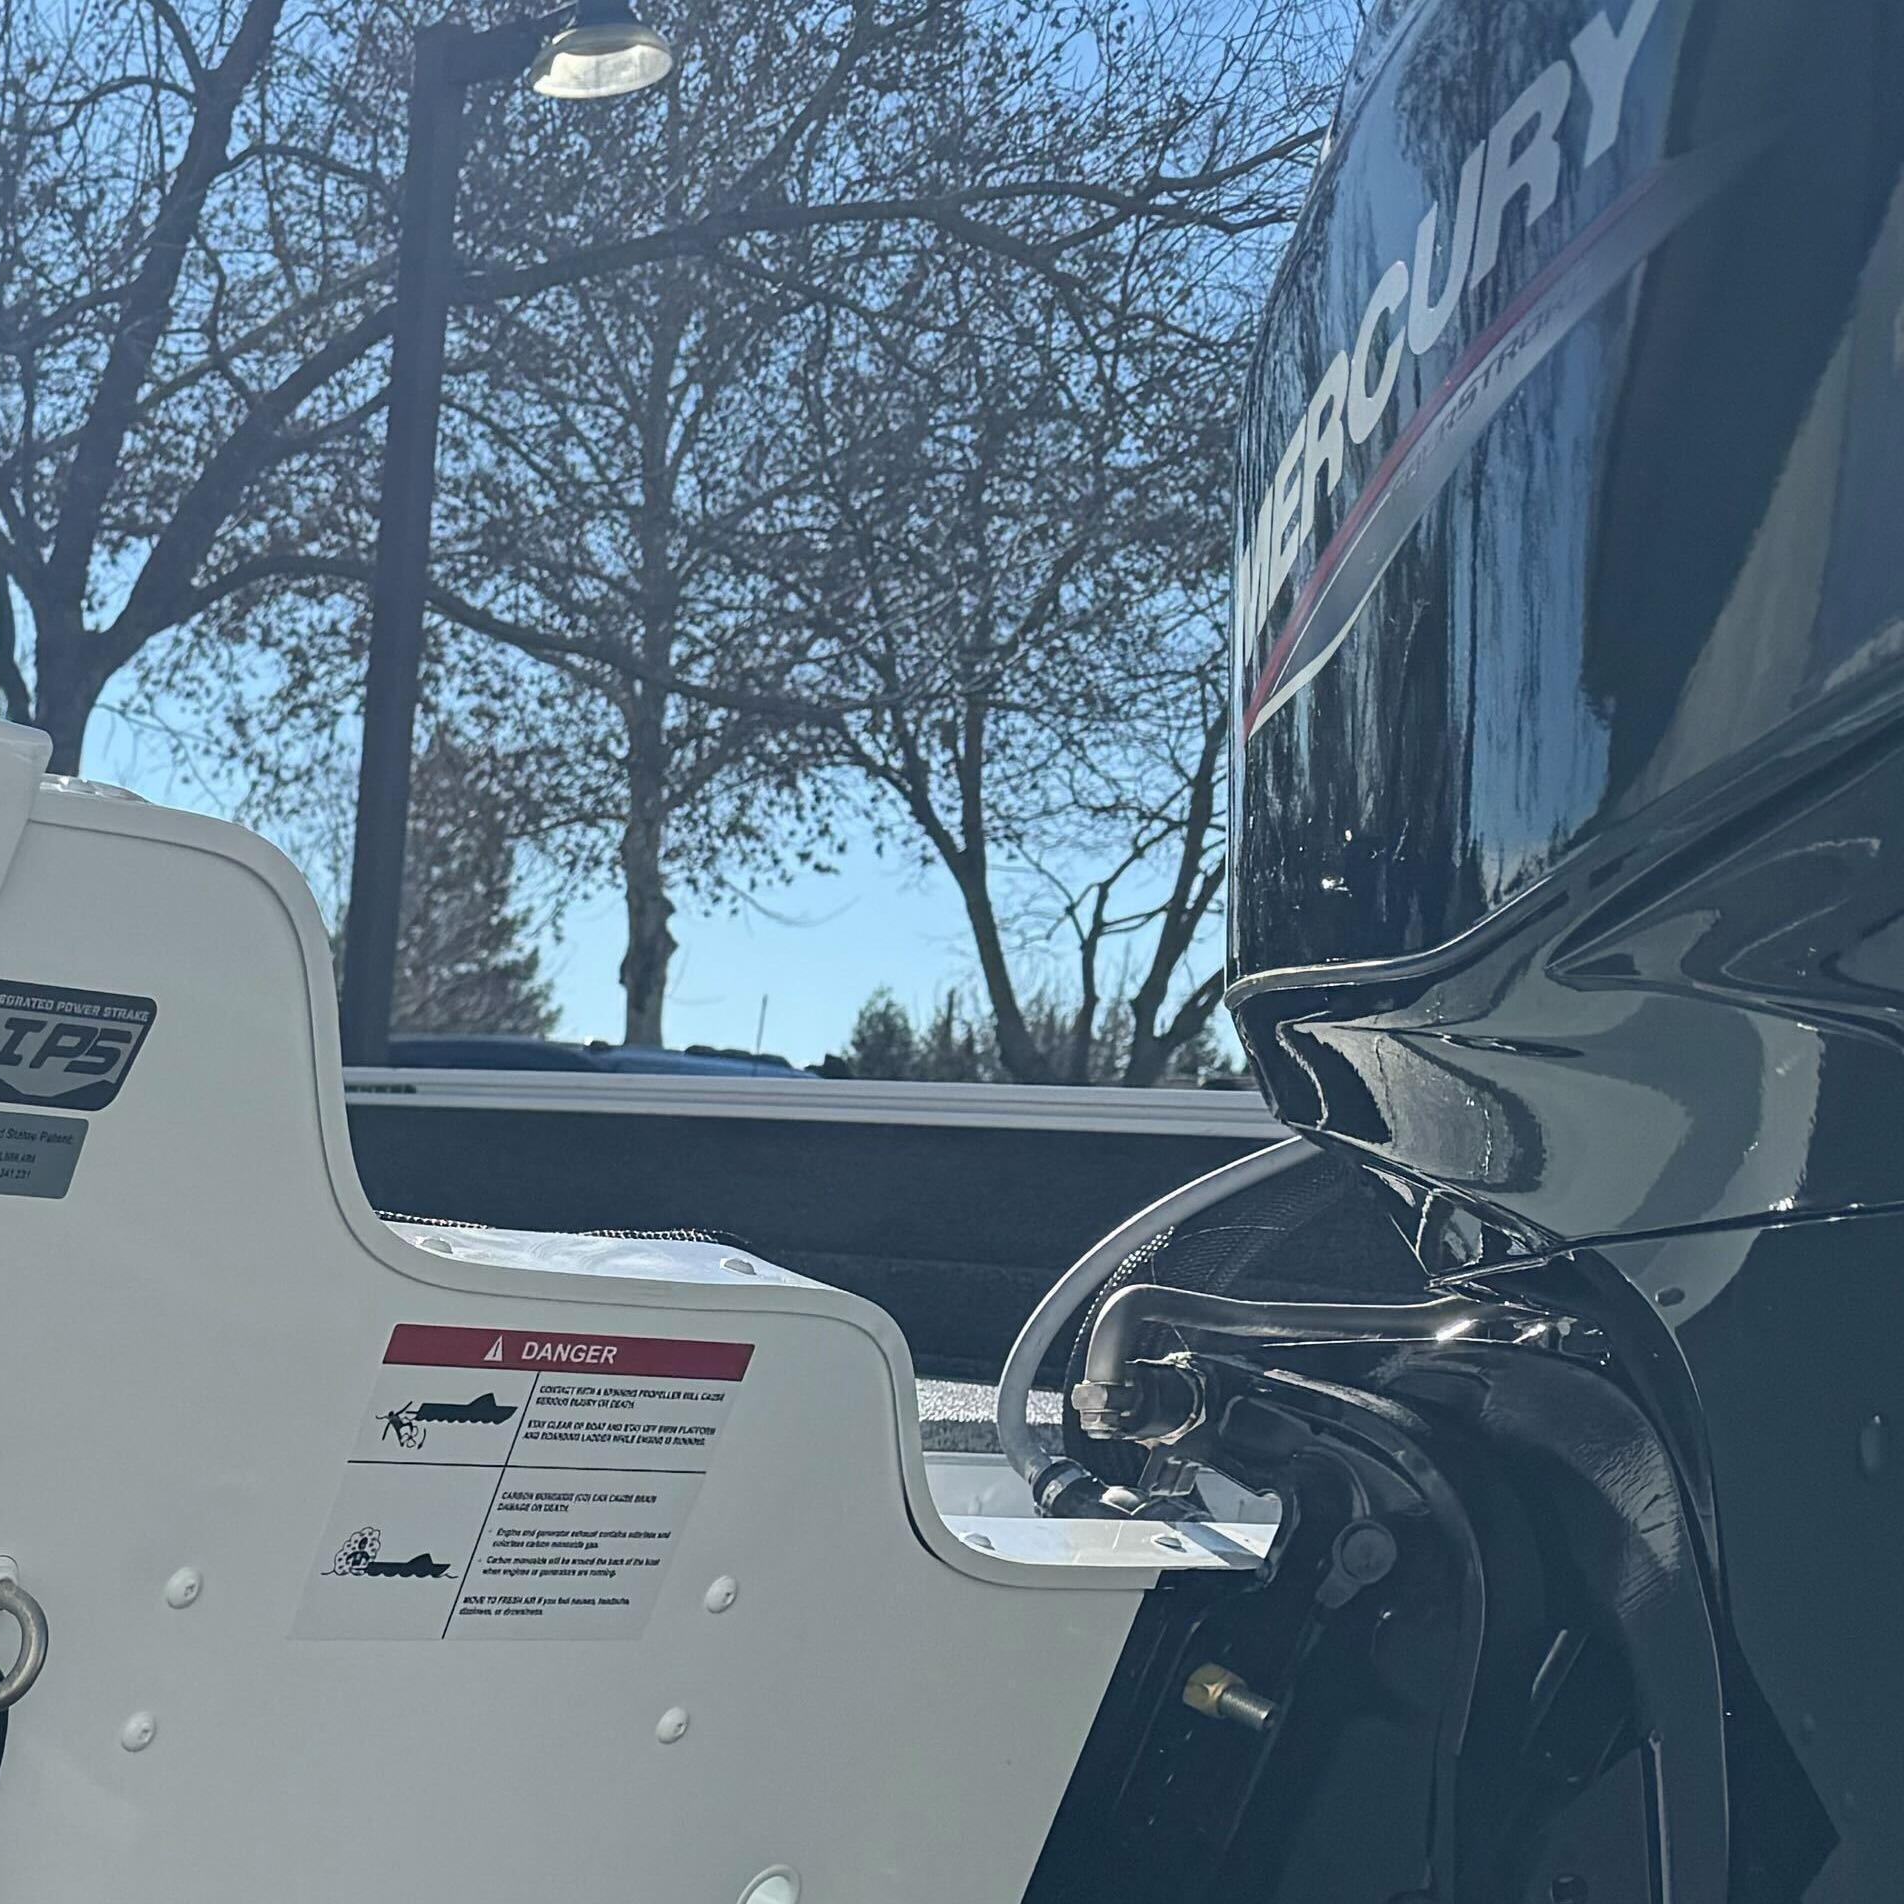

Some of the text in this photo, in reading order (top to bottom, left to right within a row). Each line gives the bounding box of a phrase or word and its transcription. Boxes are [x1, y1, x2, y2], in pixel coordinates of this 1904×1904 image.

[1241, 0, 1658, 666] MERCURY
[56, 1001, 101, 1016] POWER
[103, 1006, 150, 1022] STRAKE
[521, 1341, 618, 1365] DANGER
